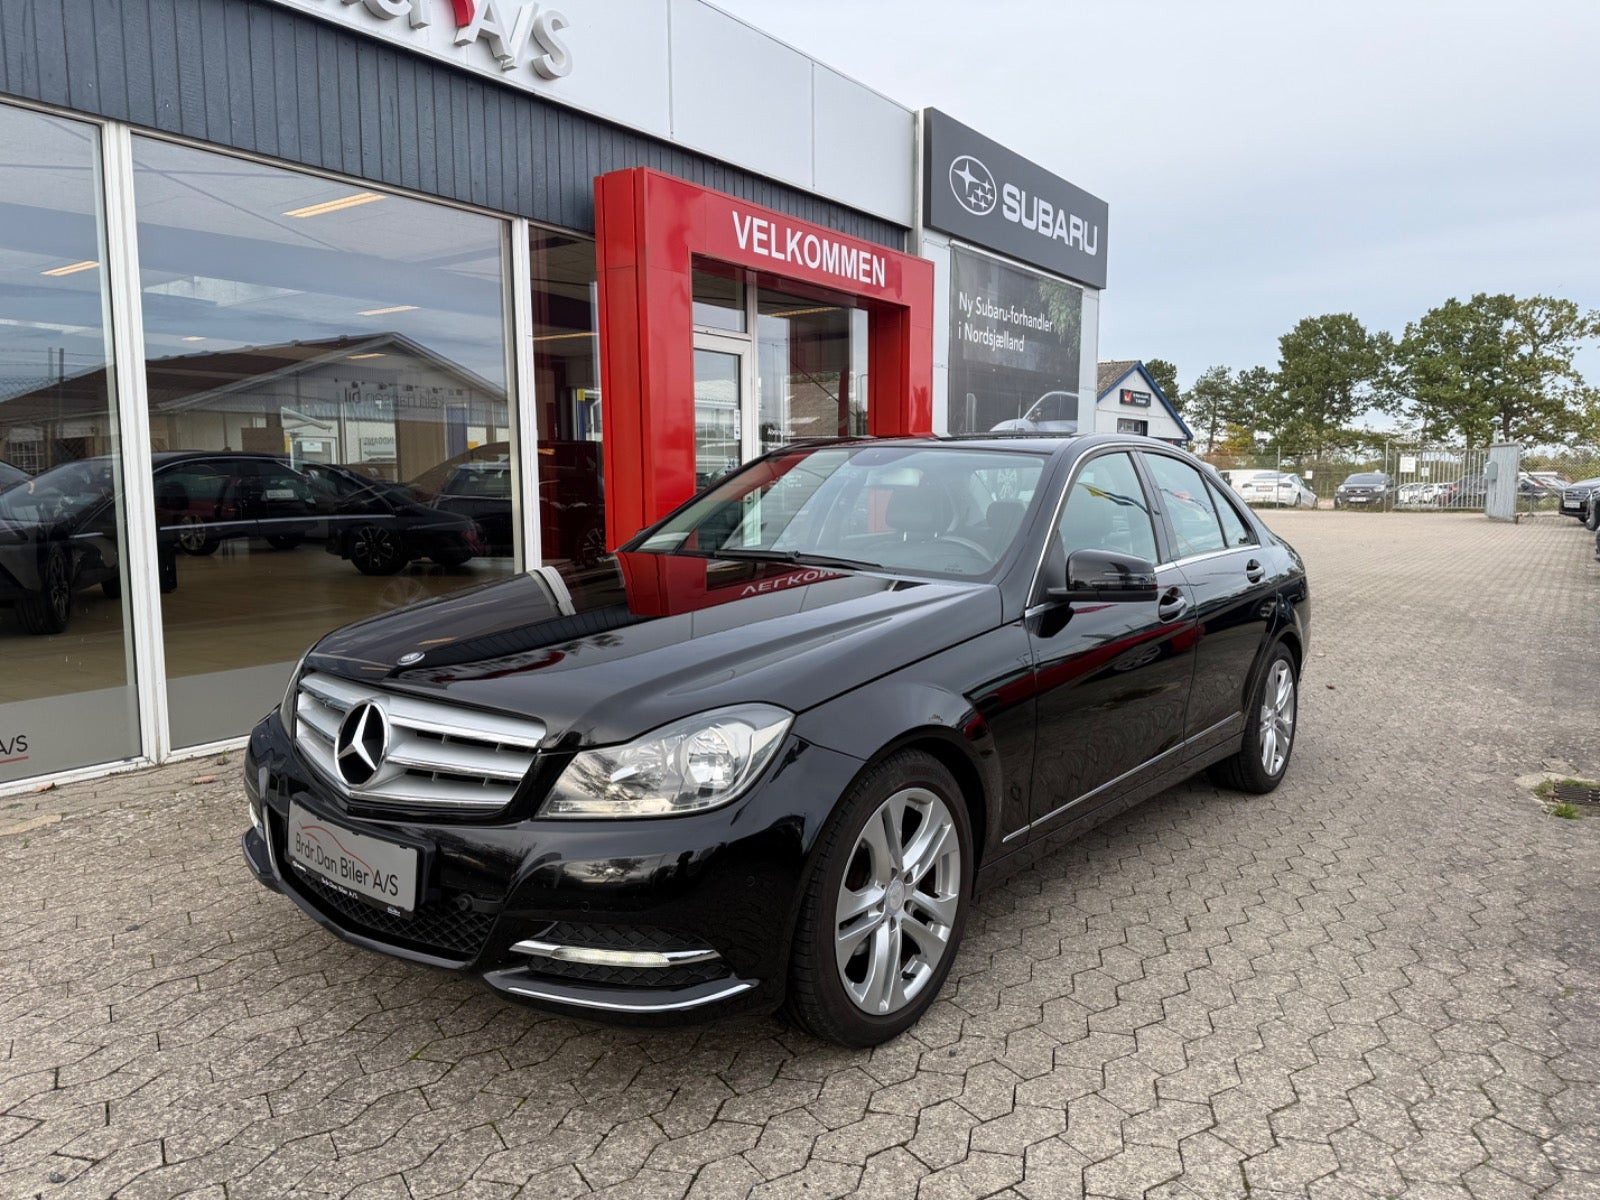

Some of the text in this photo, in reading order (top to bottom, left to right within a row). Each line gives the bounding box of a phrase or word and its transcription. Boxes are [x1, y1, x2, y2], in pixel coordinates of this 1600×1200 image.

[455, 0, 573, 80] A/S
[1002, 183, 1098, 256] SUBARU
[732, 211, 886, 287] VELKOMMEN
[958, 321, 1025, 352] i Nordsjælland
[959, 291, 1053, 332] Ny Subaru-forhandler
[340, 857, 369, 886] Biler
[372, 869, 399, 896] A/S
